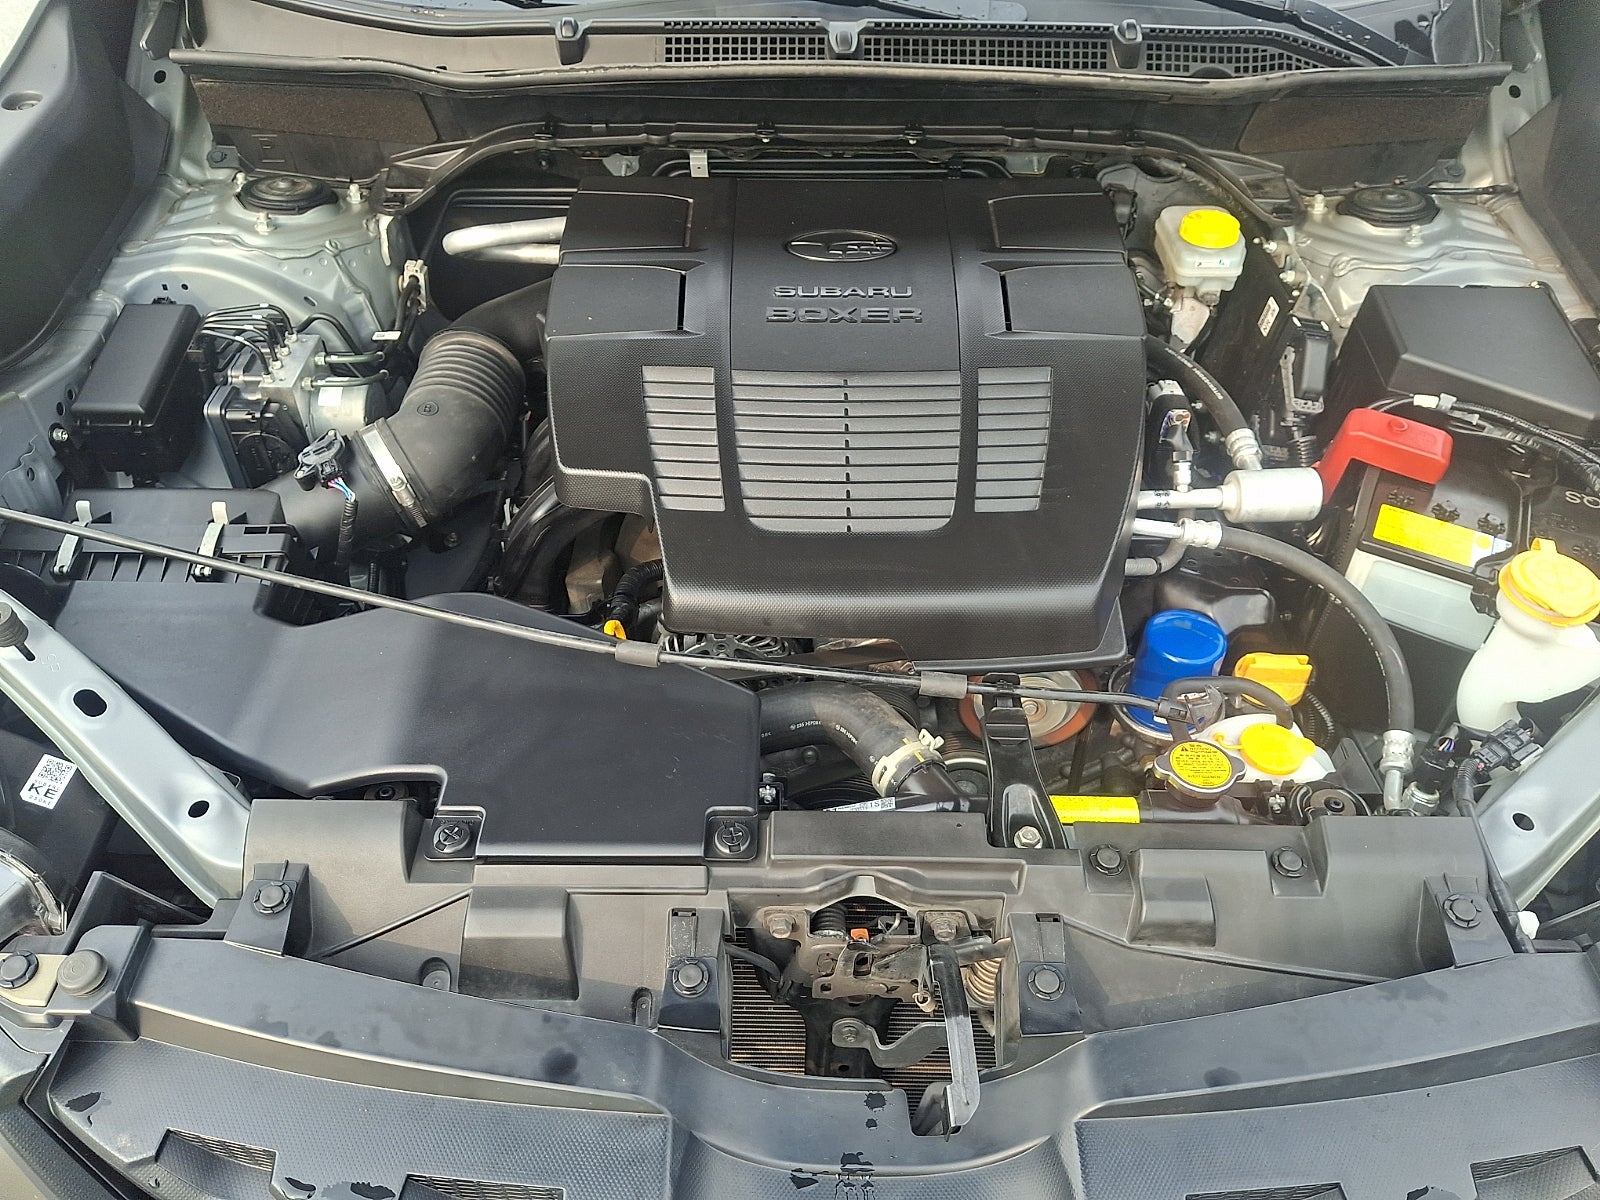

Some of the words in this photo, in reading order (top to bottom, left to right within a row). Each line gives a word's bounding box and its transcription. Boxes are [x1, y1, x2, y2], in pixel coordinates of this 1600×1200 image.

[773, 285, 913, 299] SUBARU
[766, 306, 923, 324] BOXER
[27, 783, 58, 800] KE
